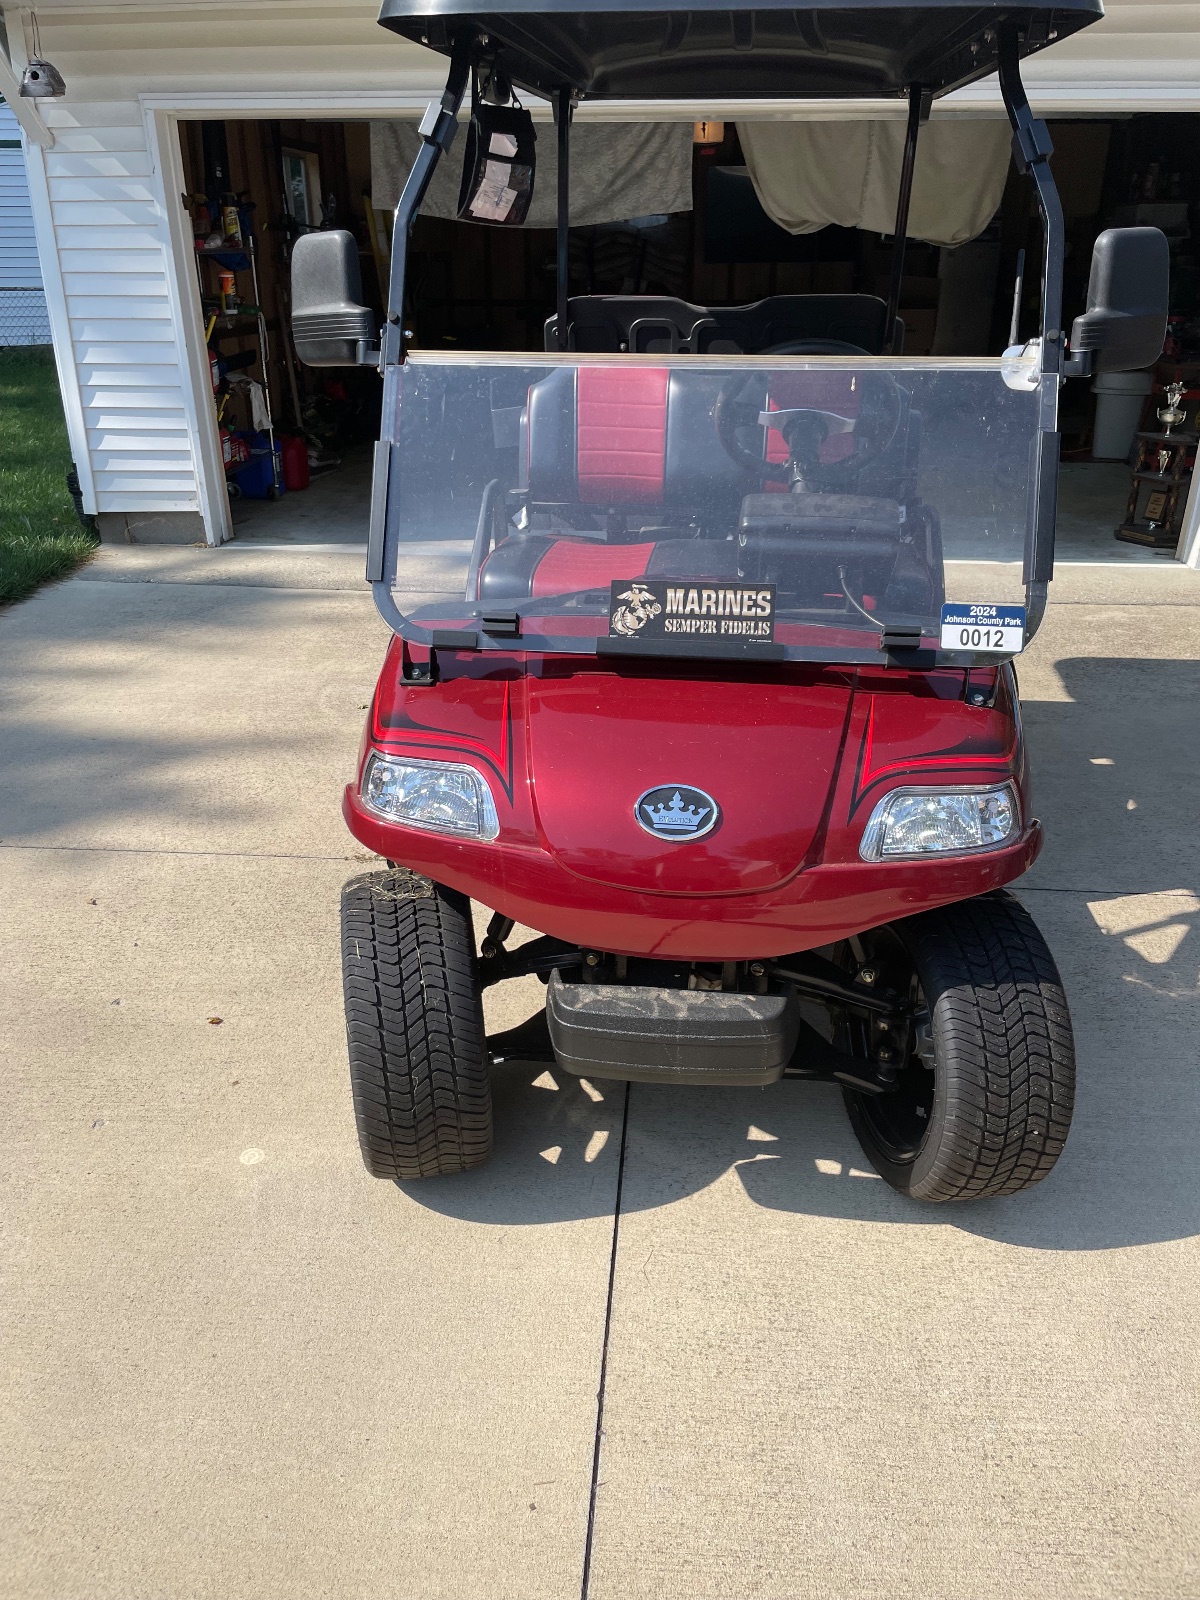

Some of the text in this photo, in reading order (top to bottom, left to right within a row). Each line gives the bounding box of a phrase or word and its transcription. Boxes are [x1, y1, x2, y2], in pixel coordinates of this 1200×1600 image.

[665, 588, 772, 617] MARINES
[969, 606, 997, 616] 2024
[664, 618, 771, 636] SEMPER FIDELIS
[944, 615, 1022, 626] Johnson County Park
[959, 628, 1004, 648] 0012
